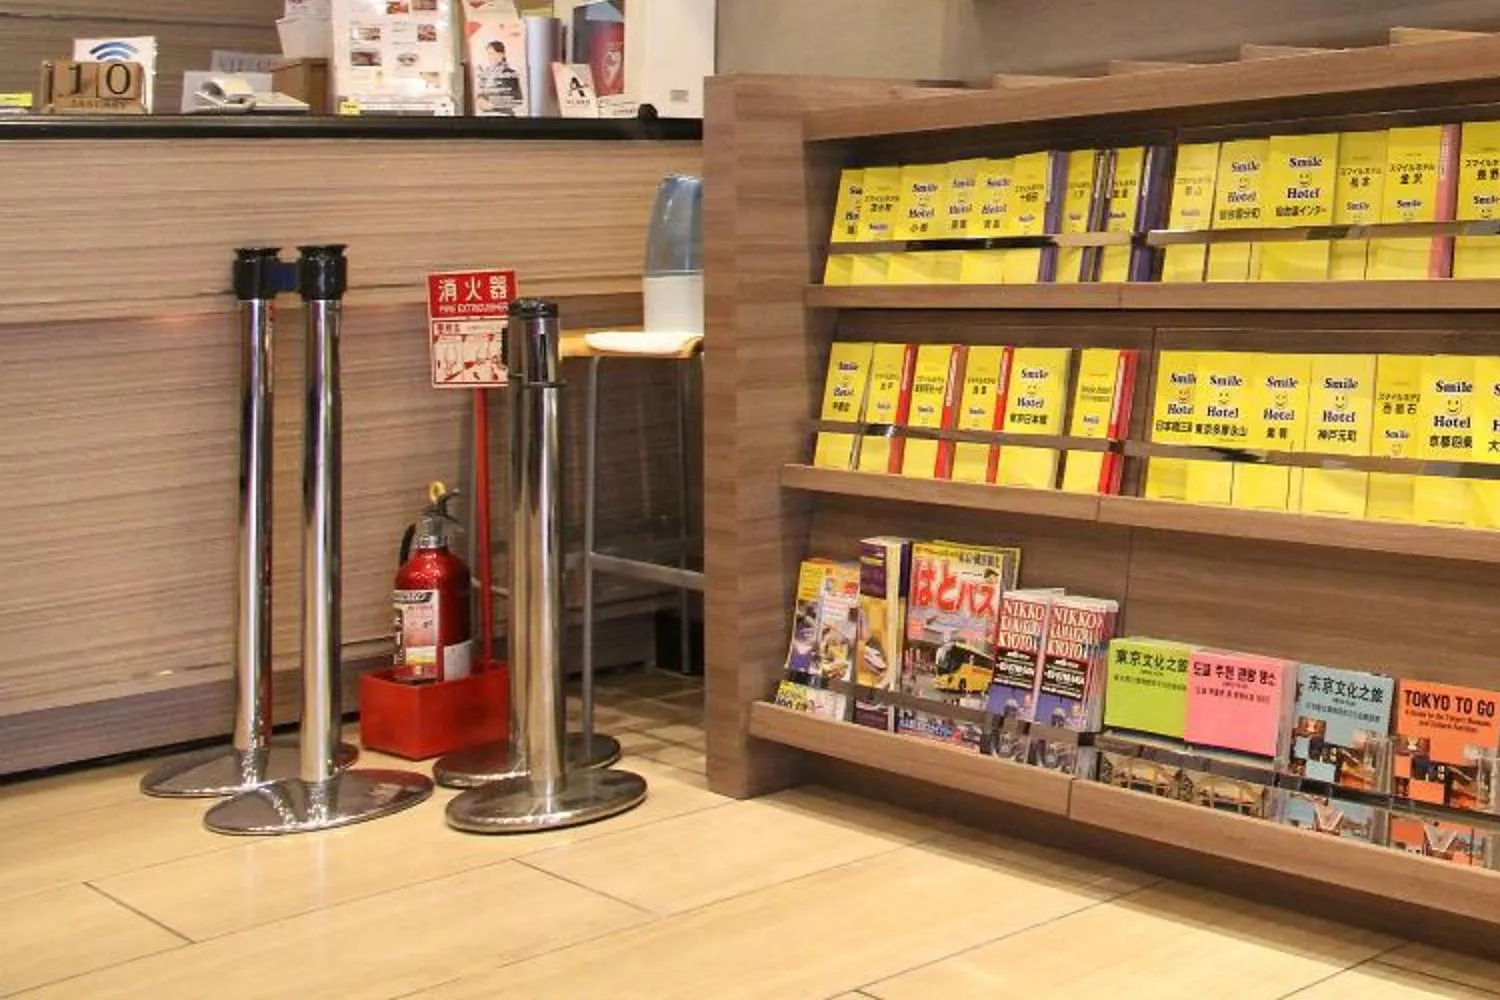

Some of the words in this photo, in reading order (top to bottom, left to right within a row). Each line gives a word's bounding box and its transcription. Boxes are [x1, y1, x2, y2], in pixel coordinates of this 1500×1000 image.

[1288, 157, 1323, 168] Smile
[1286, 186, 1320, 200] Hotel
[438, 276, 507, 303] 消火器
[1209, 375, 1243, 387] Smile
[1266, 376, 1298, 389] Smile
[1324, 378, 1358, 389] Smile
[1435, 380, 1473, 394] Smile
[1207, 406, 1240, 418] Hotel
[1263, 409, 1295, 421] Hotel
[1322, 411, 1356, 423] Hotel
[1433, 415, 1472, 429] Hotel
[1404, 689, 1451, 712] TOKYO
[1456, 696, 1473, 717] TO
[1477, 699, 1496, 719] GO
